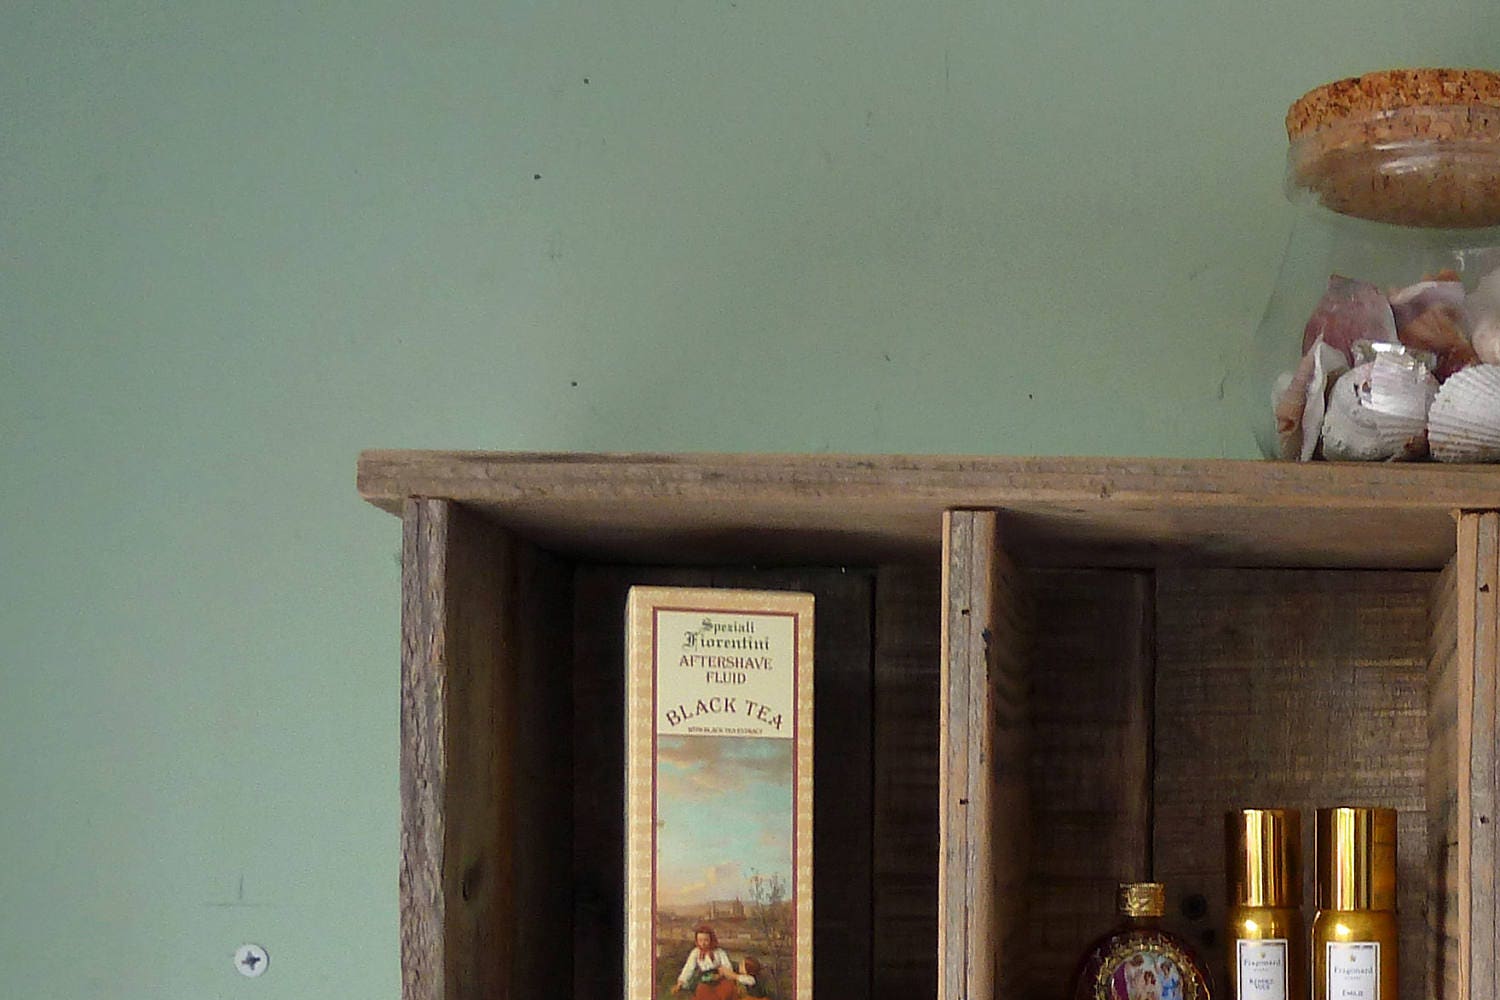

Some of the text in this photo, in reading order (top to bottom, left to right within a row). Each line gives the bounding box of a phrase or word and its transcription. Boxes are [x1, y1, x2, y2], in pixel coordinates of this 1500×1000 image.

[683, 631, 769, 652] Fiorentini
[680, 655, 773, 670] AFTERSHAVE
[706, 671, 747, 684] FLUID
[666, 697, 783, 730] BLACK TEA
